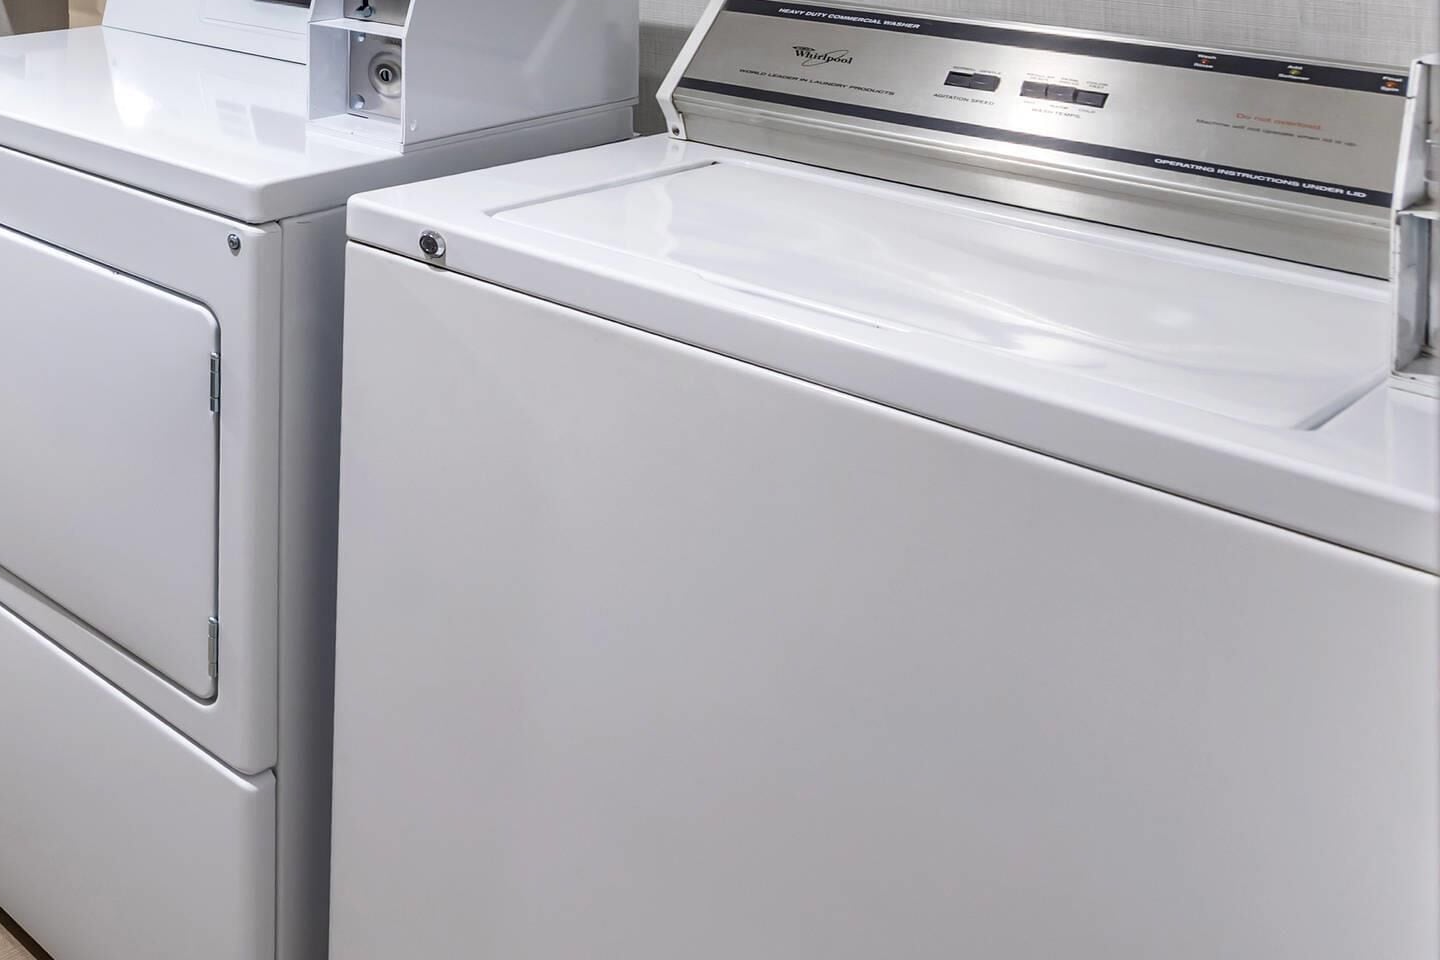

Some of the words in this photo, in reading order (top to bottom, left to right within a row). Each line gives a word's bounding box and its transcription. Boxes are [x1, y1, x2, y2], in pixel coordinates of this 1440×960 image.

[778, 7, 805, 15] HEAVY
[828, 13, 882, 25] COMMERCIAL
[883, 20, 921, 29] WASHER
[794, 48, 853, 66] Whirlpool
[739, 68, 766, 76] WORLD
[768, 73, 799, 81] LEADER
[810, 80, 848, 88] LAUNDRY
[849, 85, 895, 96] PRODUCTS
[1154, 157, 1215, 173] OPERATING
[1217, 168, 1300, 187] INSTRUCTIONS
[1302, 182, 1345, 195] UNDER
[1346, 190, 1368, 198] LID
